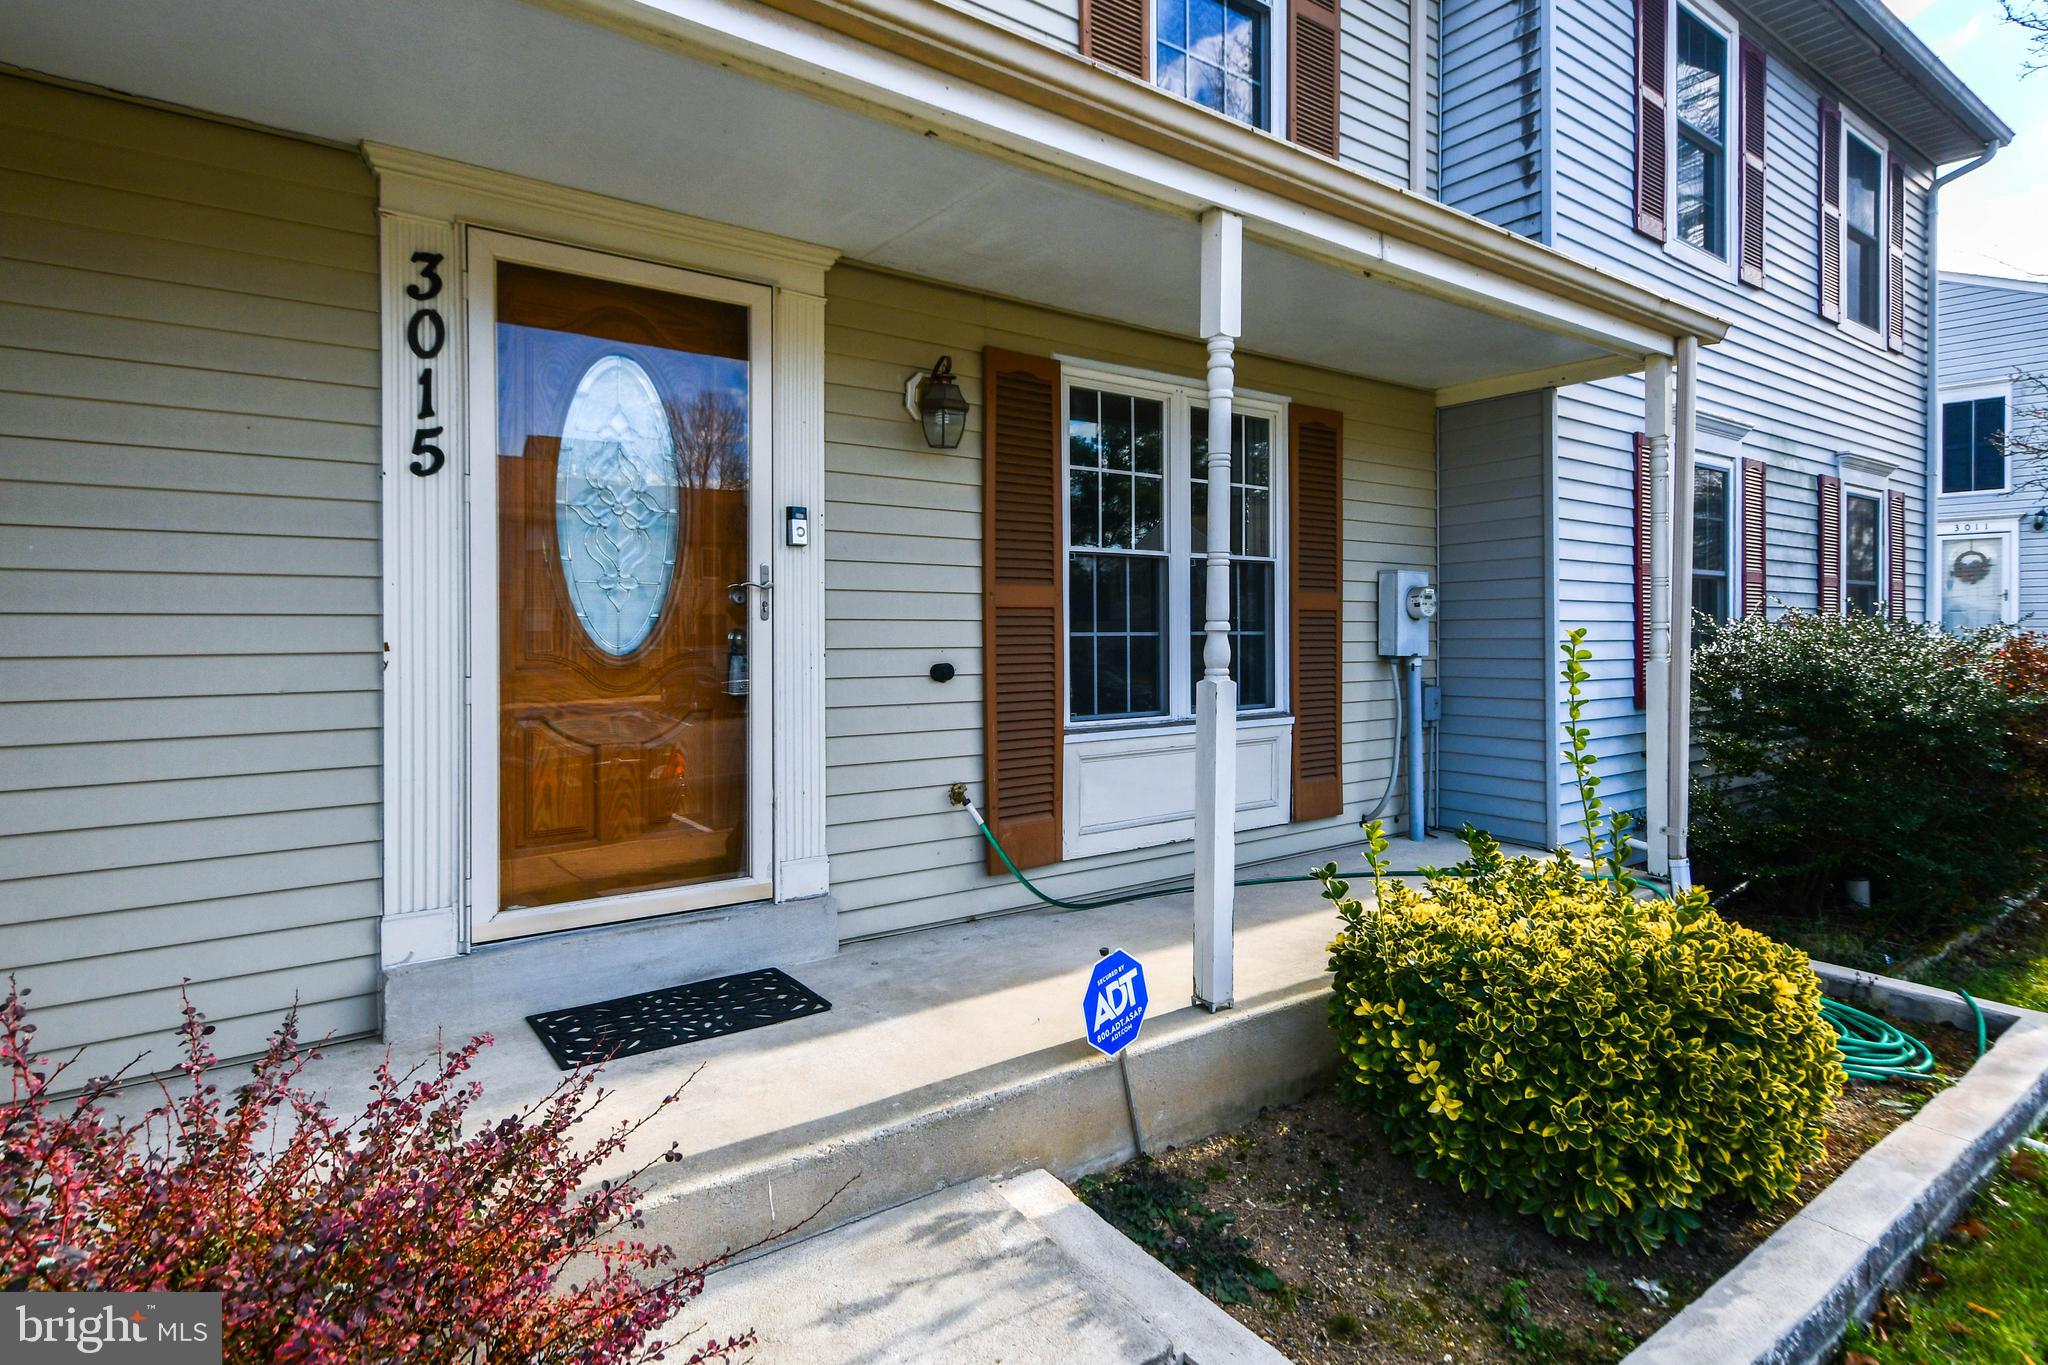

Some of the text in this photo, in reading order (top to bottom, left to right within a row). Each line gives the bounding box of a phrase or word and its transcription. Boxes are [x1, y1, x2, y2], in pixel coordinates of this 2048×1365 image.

[406, 251, 446, 477] 3015
[1954, 523, 1989, 532] 3011
[1097, 964, 1125, 987] SECURED BY
[1093, 967, 1138, 1033] ADT
[1097, 1006, 1143, 1044] 800.ADT.ASAP
[1111, 1023, 1133, 1042] ADT.COM
